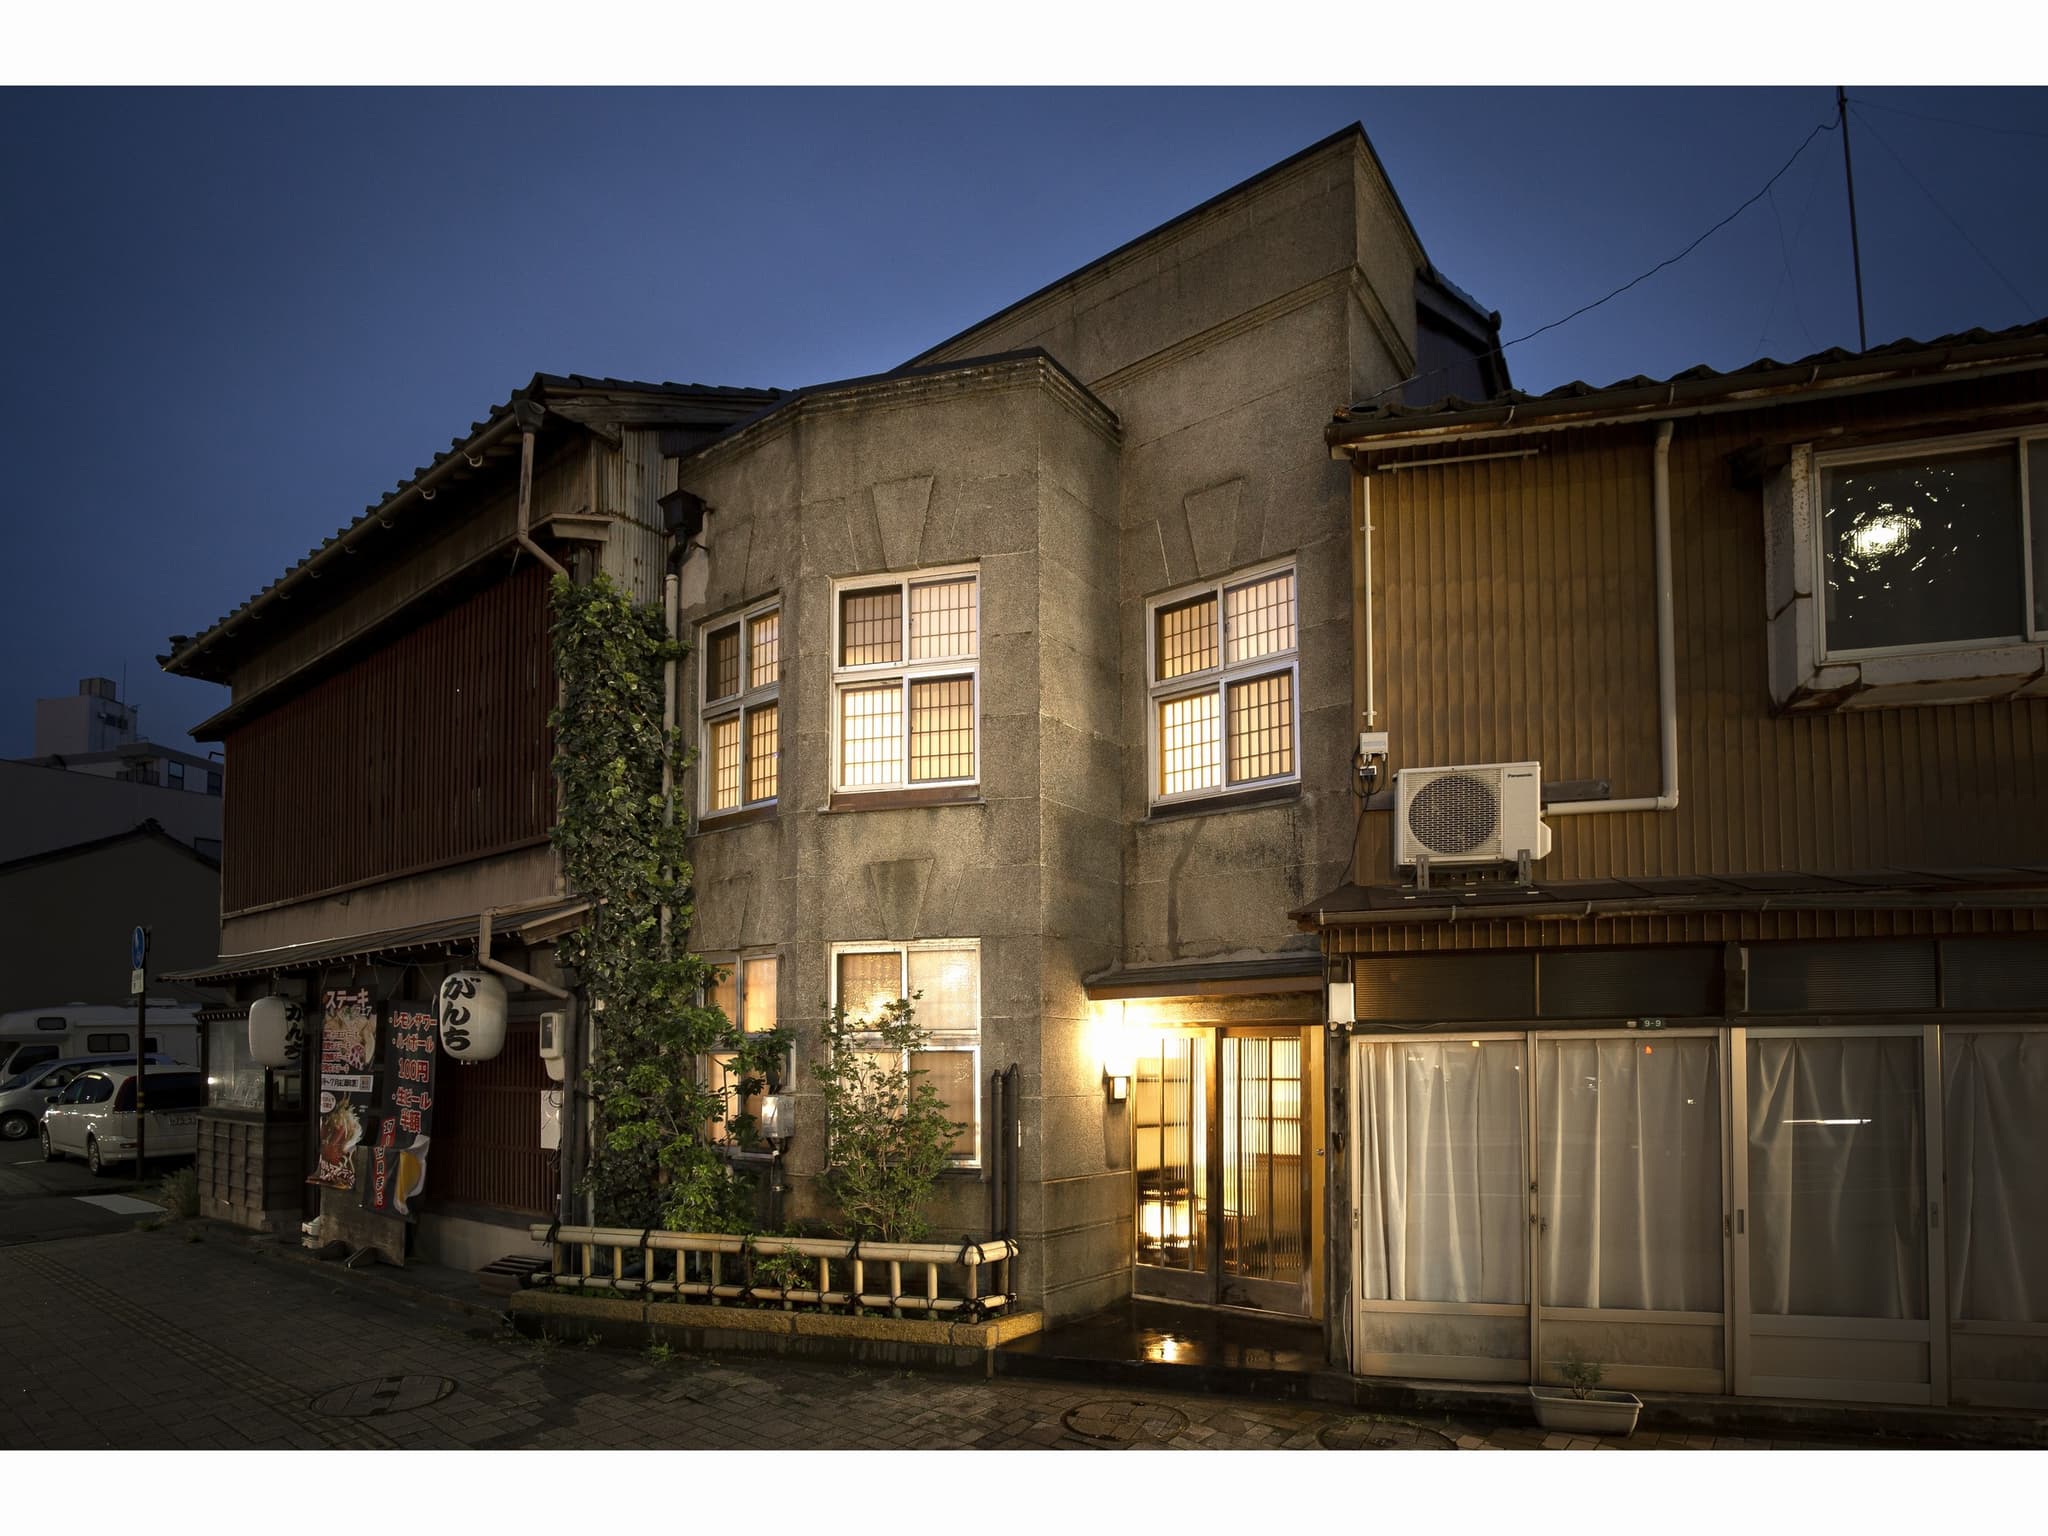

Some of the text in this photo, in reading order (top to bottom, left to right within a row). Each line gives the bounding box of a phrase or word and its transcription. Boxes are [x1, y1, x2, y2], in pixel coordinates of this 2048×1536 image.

[325, 988, 369, 1009] ステーキ
[399, 1058, 430, 1083] 100円
[400, 1108, 422, 1133] 半額
